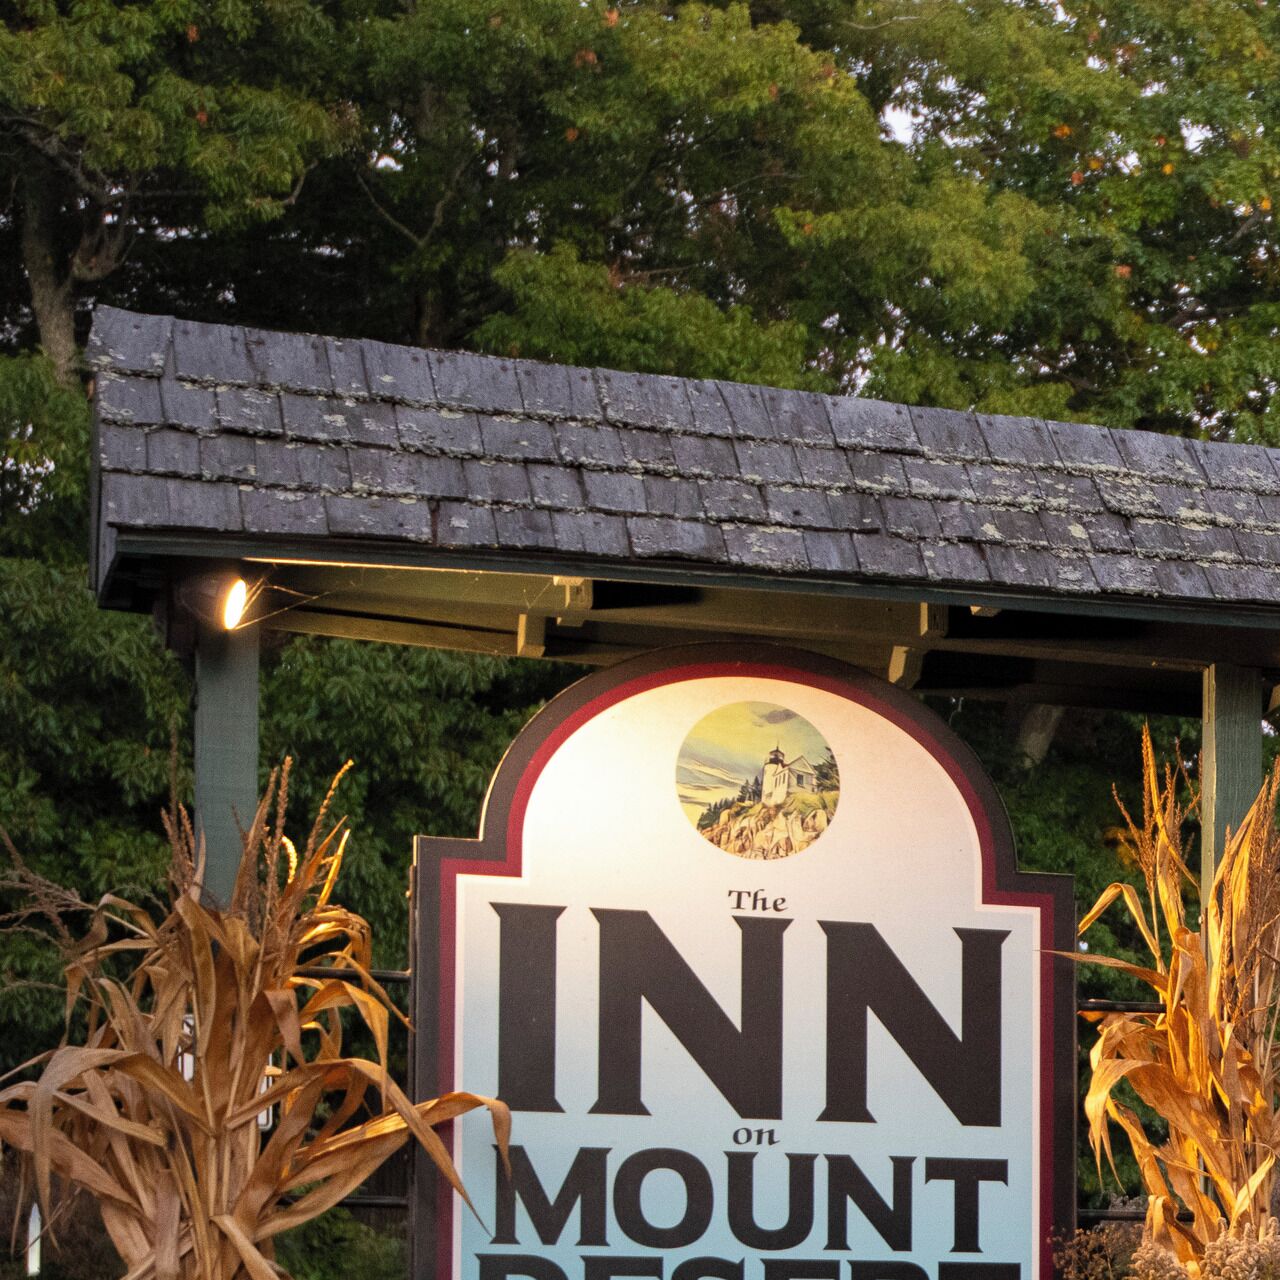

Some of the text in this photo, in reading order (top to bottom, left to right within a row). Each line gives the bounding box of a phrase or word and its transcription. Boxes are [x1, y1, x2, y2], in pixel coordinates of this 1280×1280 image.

[728, 888, 788, 913] The
[489, 901, 1012, 1127] INN
[732, 1125, 780, 1147] on
[489, 1145, 1009, 1253] MOUNT
